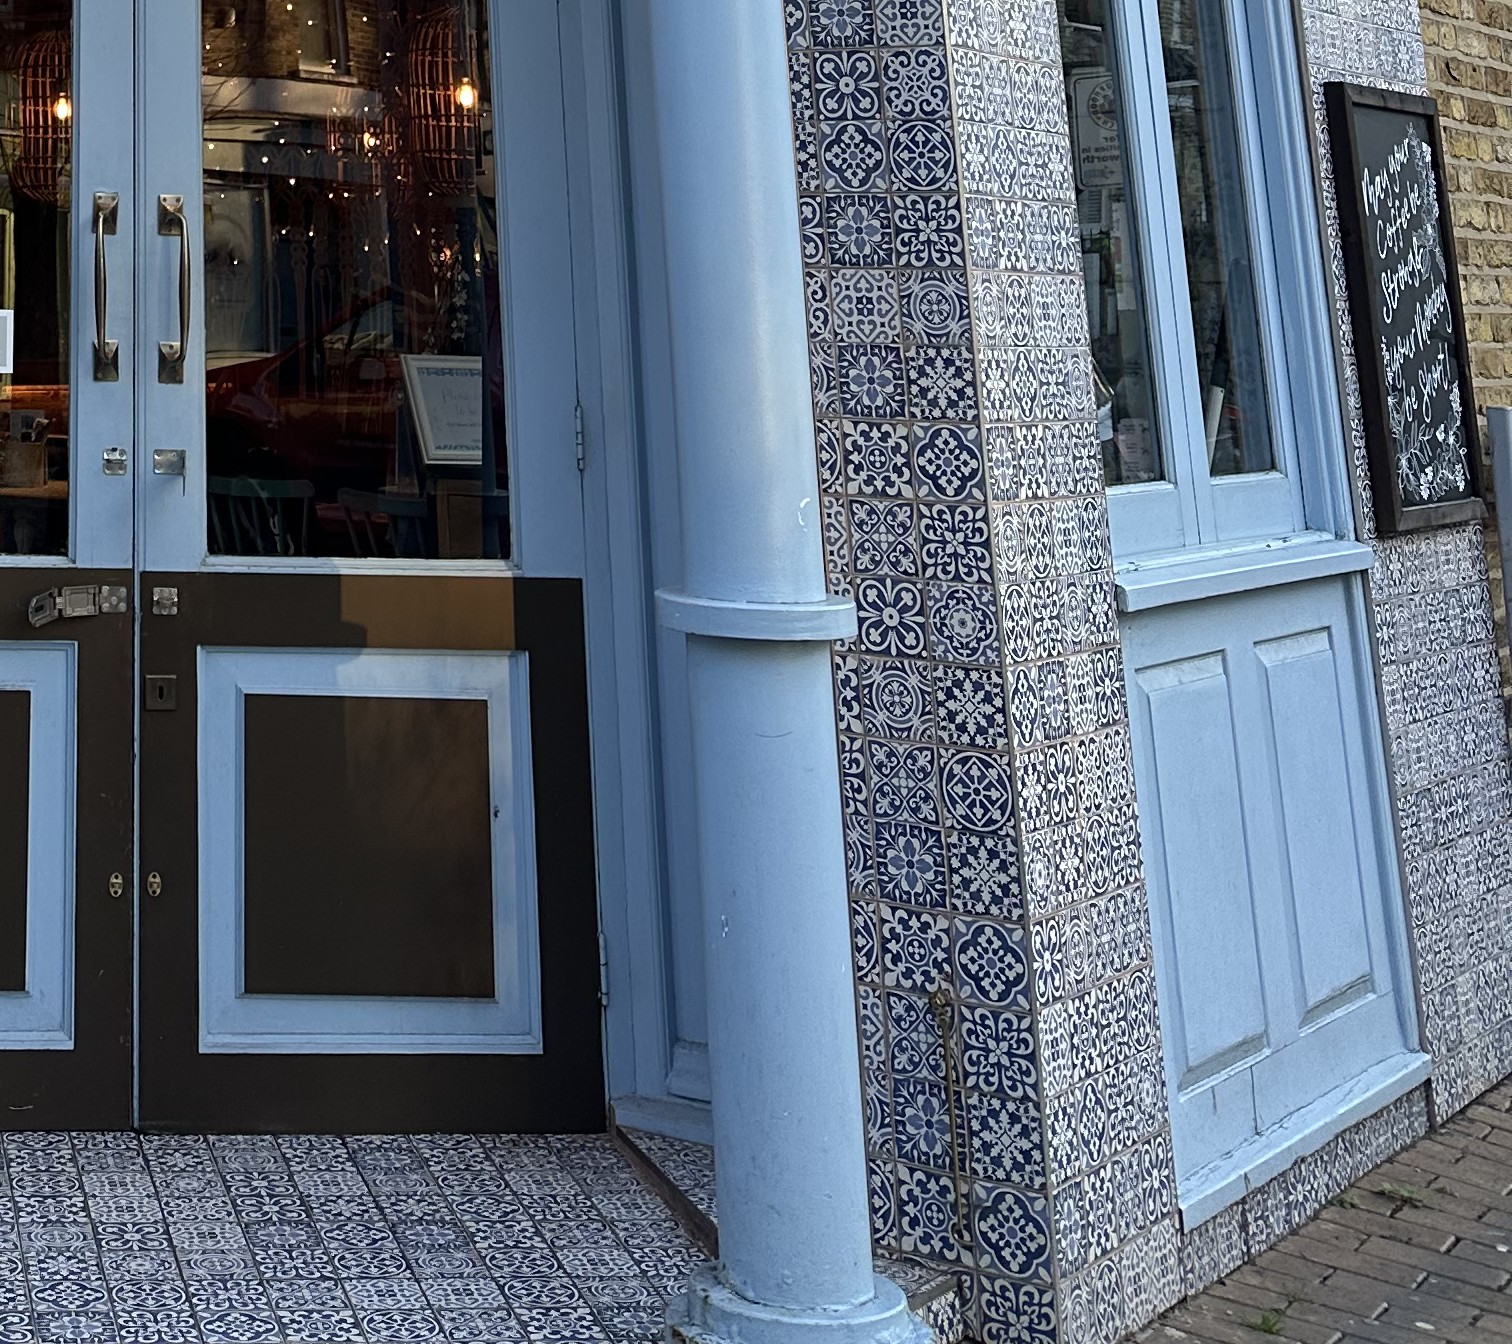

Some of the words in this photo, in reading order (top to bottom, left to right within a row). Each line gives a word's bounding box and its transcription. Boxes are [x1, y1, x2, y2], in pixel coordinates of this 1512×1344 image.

[1361, 166, 1394, 217] May
[1388, 137, 1411, 194] your
[1375, 197, 1412, 260] Coffee
[1406, 179, 1422, 215] be
[1389, 327, 1416, 389] your
[1402, 378, 1419, 422] be
